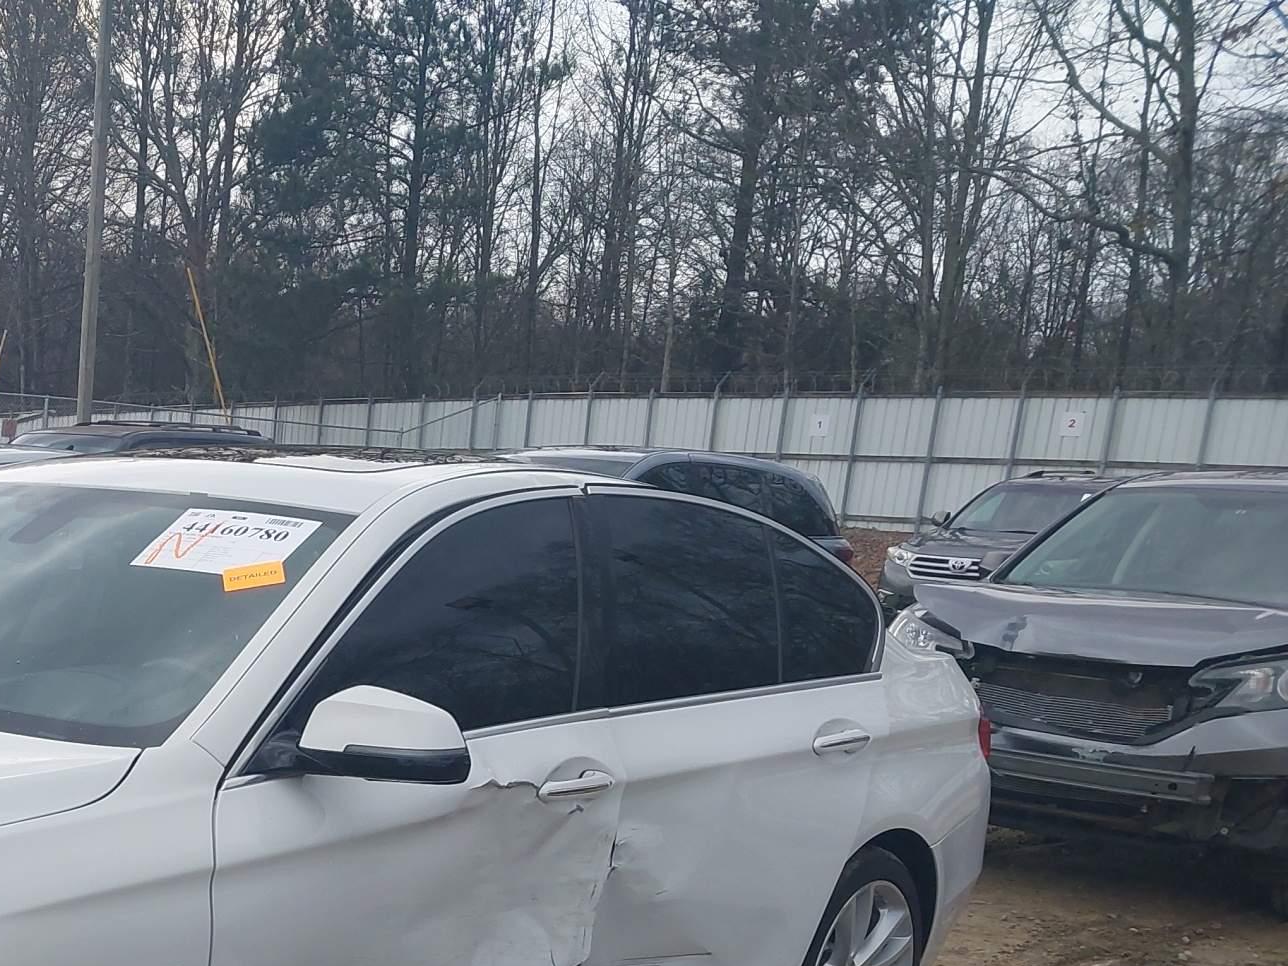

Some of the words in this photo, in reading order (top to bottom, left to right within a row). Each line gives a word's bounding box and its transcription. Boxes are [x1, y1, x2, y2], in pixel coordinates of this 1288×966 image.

[1068, 419, 1076, 428] 2
[183, 521, 289, 542] 44160780
[229, 570, 277, 582] DETAILED
